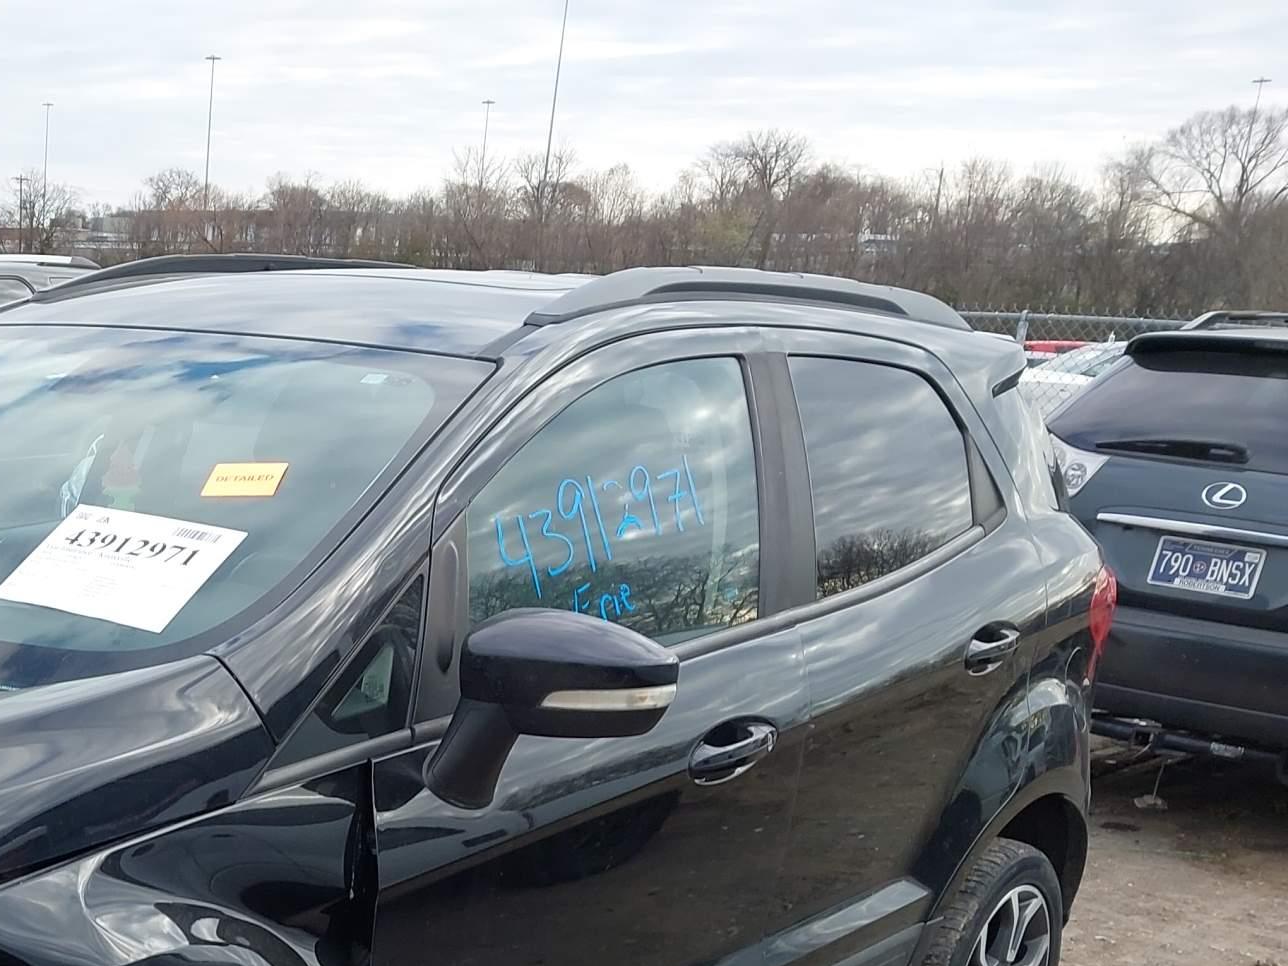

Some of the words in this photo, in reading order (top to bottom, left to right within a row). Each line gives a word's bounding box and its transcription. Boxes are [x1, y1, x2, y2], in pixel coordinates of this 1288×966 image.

[64, 529, 201, 567] 43912971
[1159, 550, 1194, 577] 790
[1205, 557, 1255, 587] BNSX
